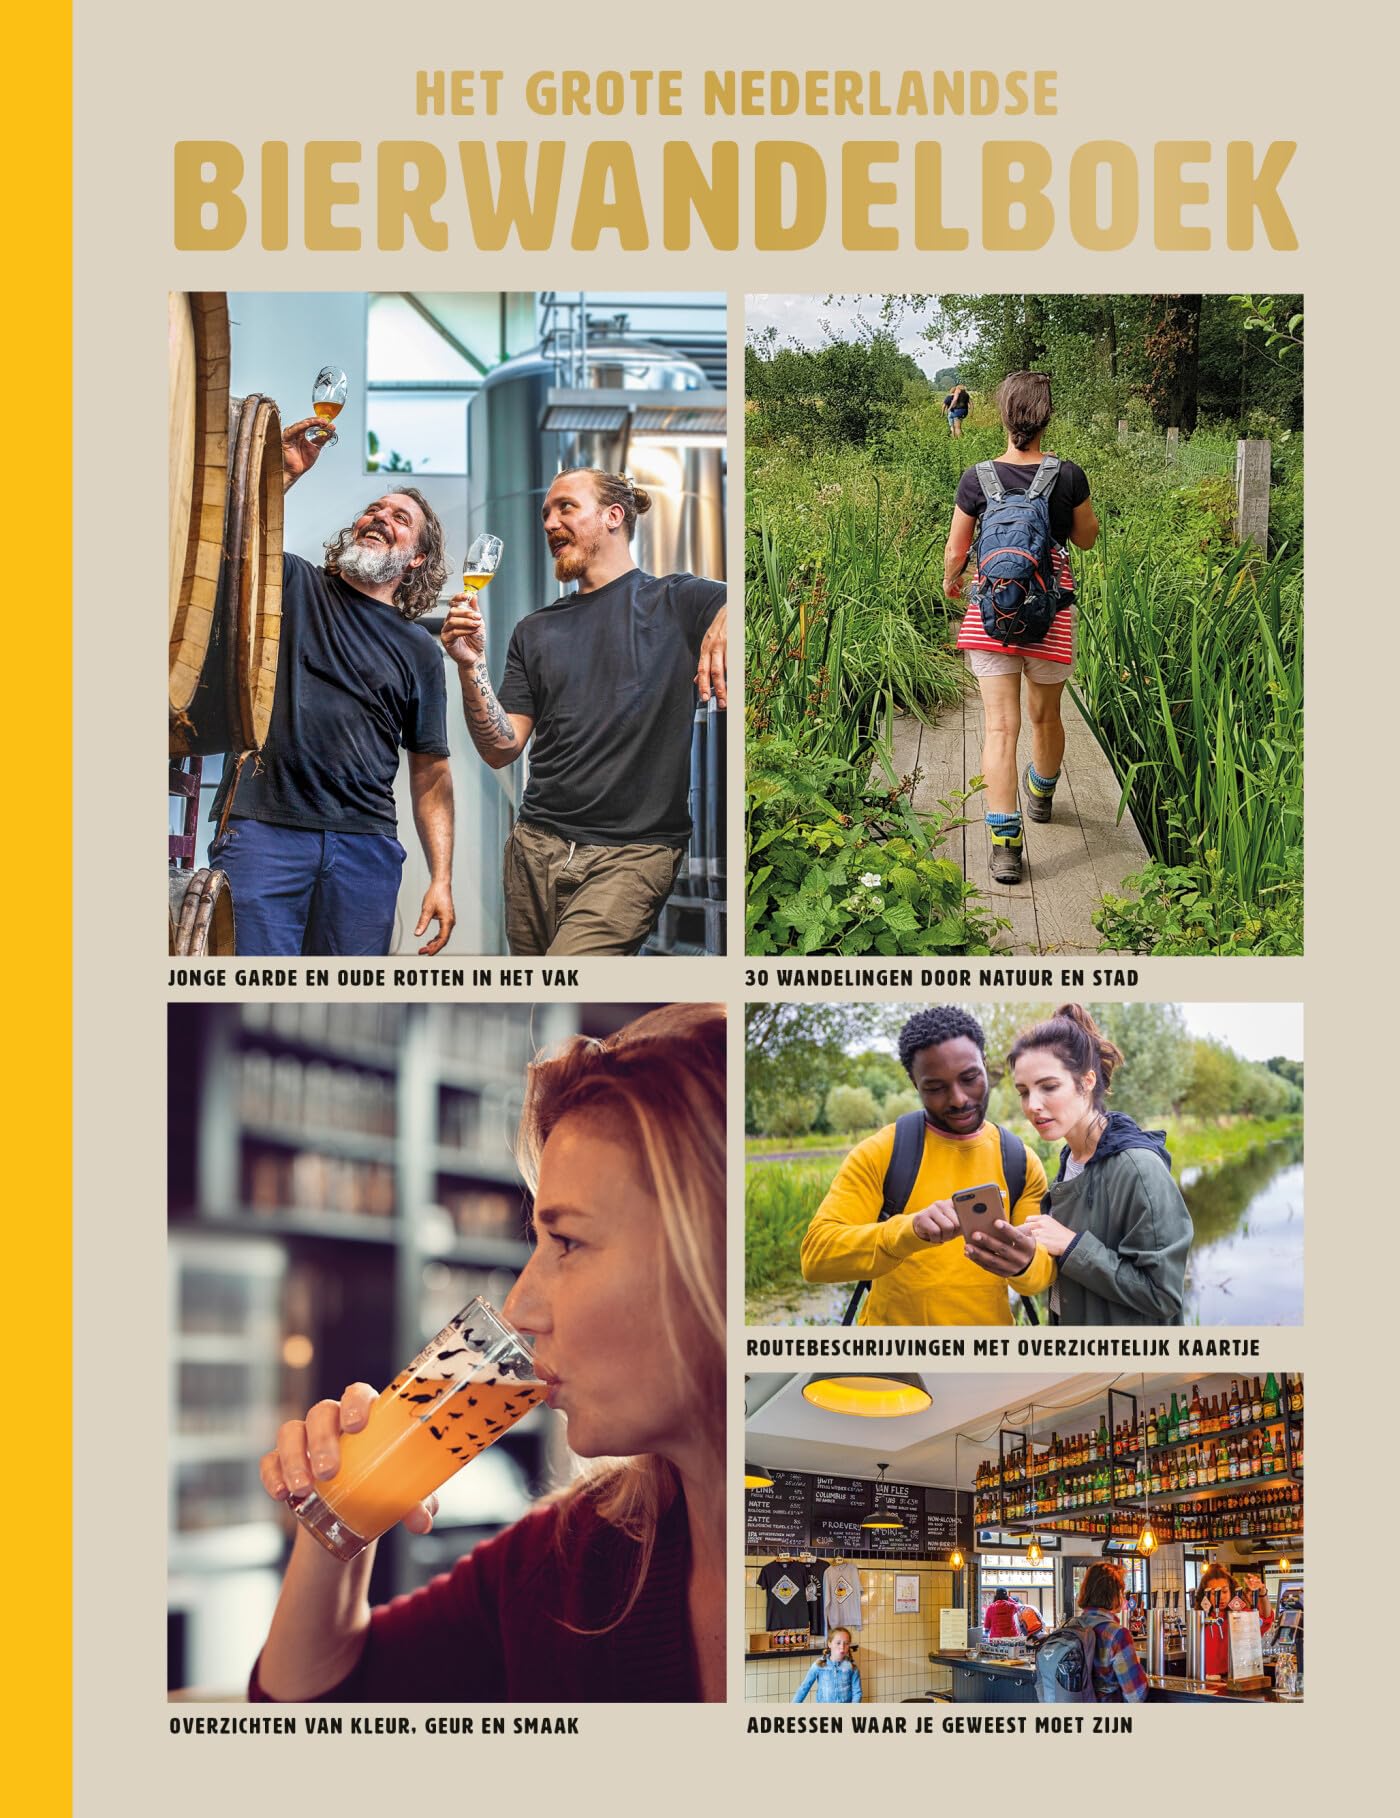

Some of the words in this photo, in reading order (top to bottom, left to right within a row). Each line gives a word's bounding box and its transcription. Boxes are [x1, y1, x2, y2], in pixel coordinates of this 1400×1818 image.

[890, 1486, 909, 1495] FLES
[815, 1491, 847, 1500] COLUMBUS
[748, 1500, 771, 1508] NATTE
